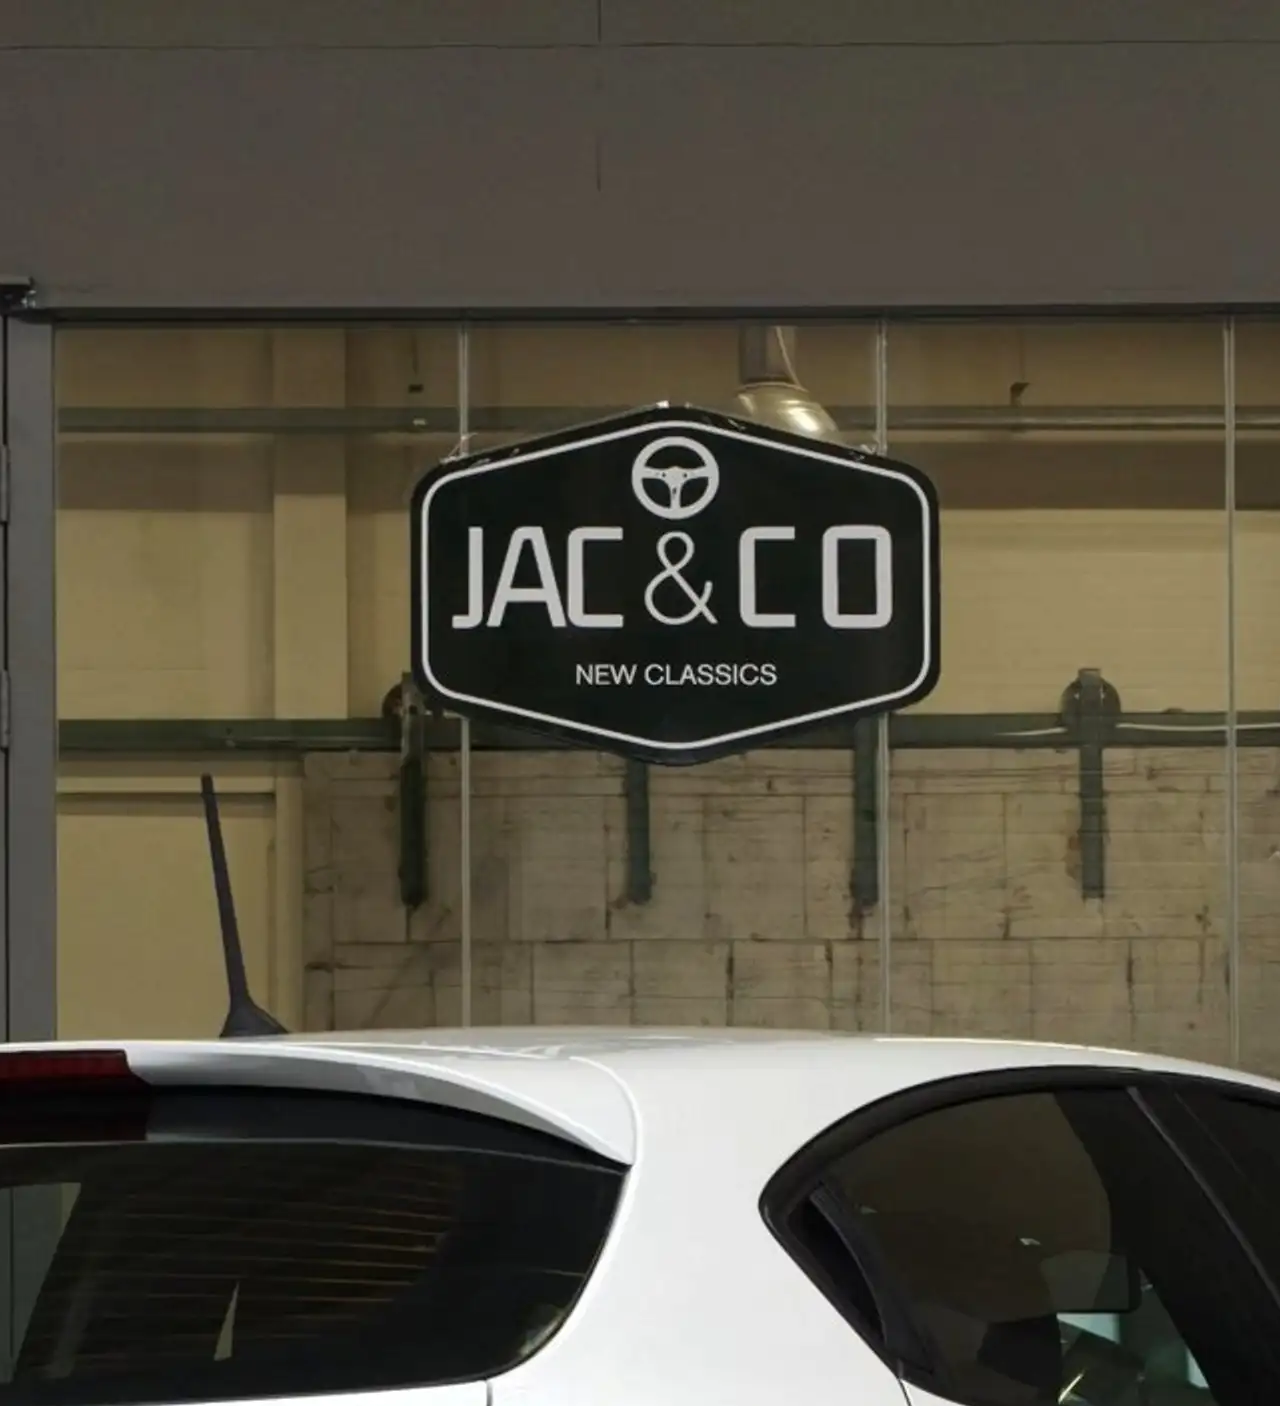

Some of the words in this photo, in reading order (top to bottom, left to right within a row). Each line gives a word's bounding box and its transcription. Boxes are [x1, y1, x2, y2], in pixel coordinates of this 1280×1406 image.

[451, 525, 624, 629] JAC
[643, 531, 718, 626] &
[739, 525, 893, 629] CO
[575, 663, 637, 686] NEW
[644, 663, 777, 687] CLASSICS
